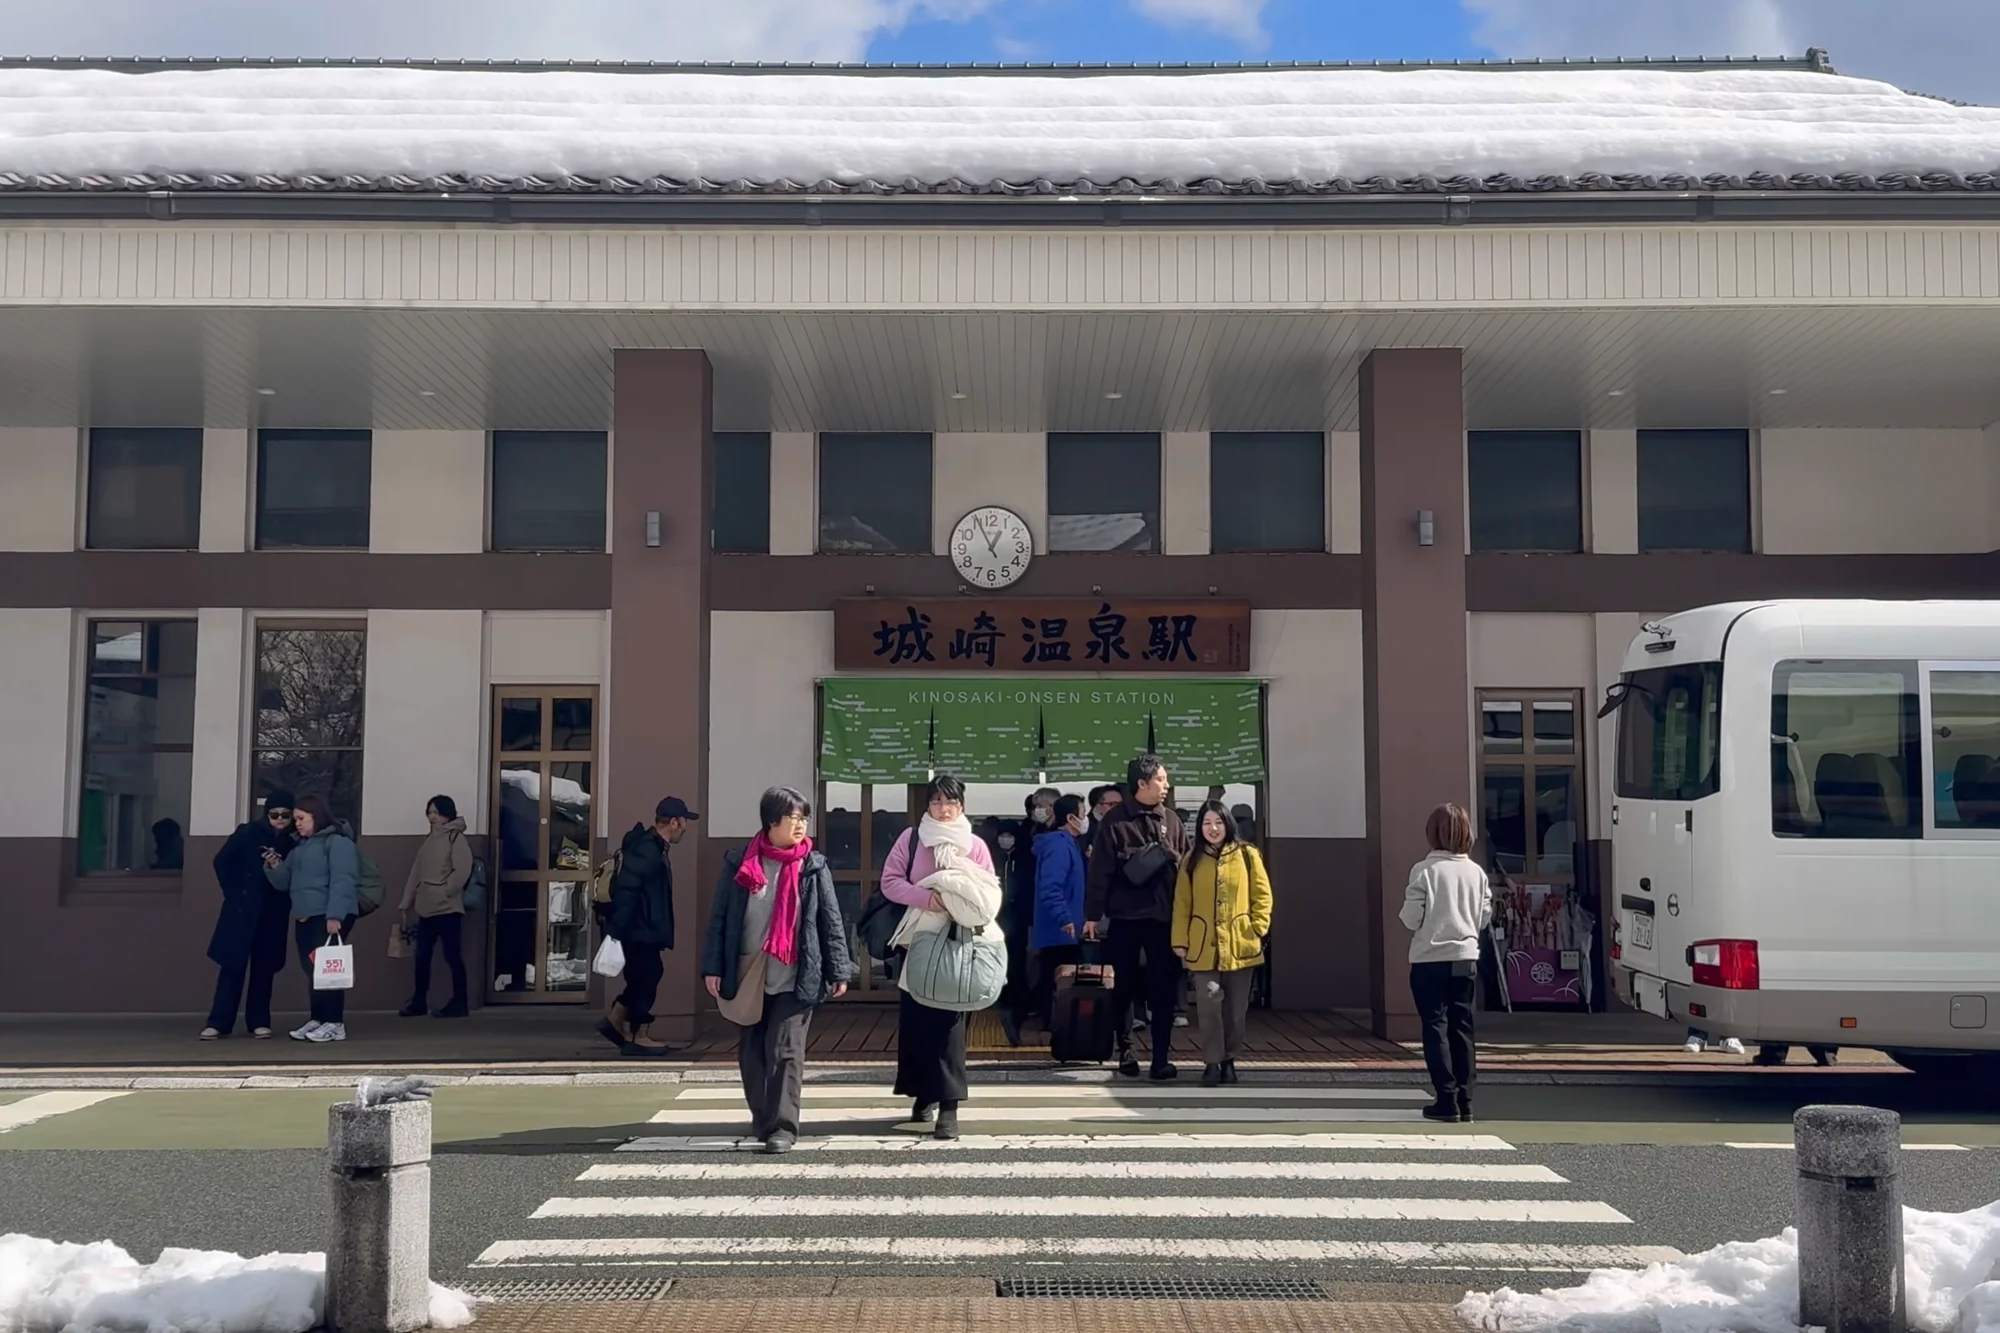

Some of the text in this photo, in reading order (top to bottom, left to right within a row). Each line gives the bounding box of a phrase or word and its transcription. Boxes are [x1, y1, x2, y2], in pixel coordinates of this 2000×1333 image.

[985, 515, 998, 527] 12
[961, 528, 974, 541] 10
[1011, 527, 1021, 539] 2
[957, 543, 967, 555] 9
[1015, 541, 1025, 553] 3
[963, 556, 972, 568] 8
[1011, 555, 1021, 567] 4
[974, 567, 983, 578] 7
[987, 569, 996, 581] 6
[1001, 566, 1010, 578] 5
[873, 603, 1197, 667] 城崎温泉駅
[908, 691, 1175, 705] KINOSAKI-ONSEN STATION
[325, 959, 343, 968] 551
